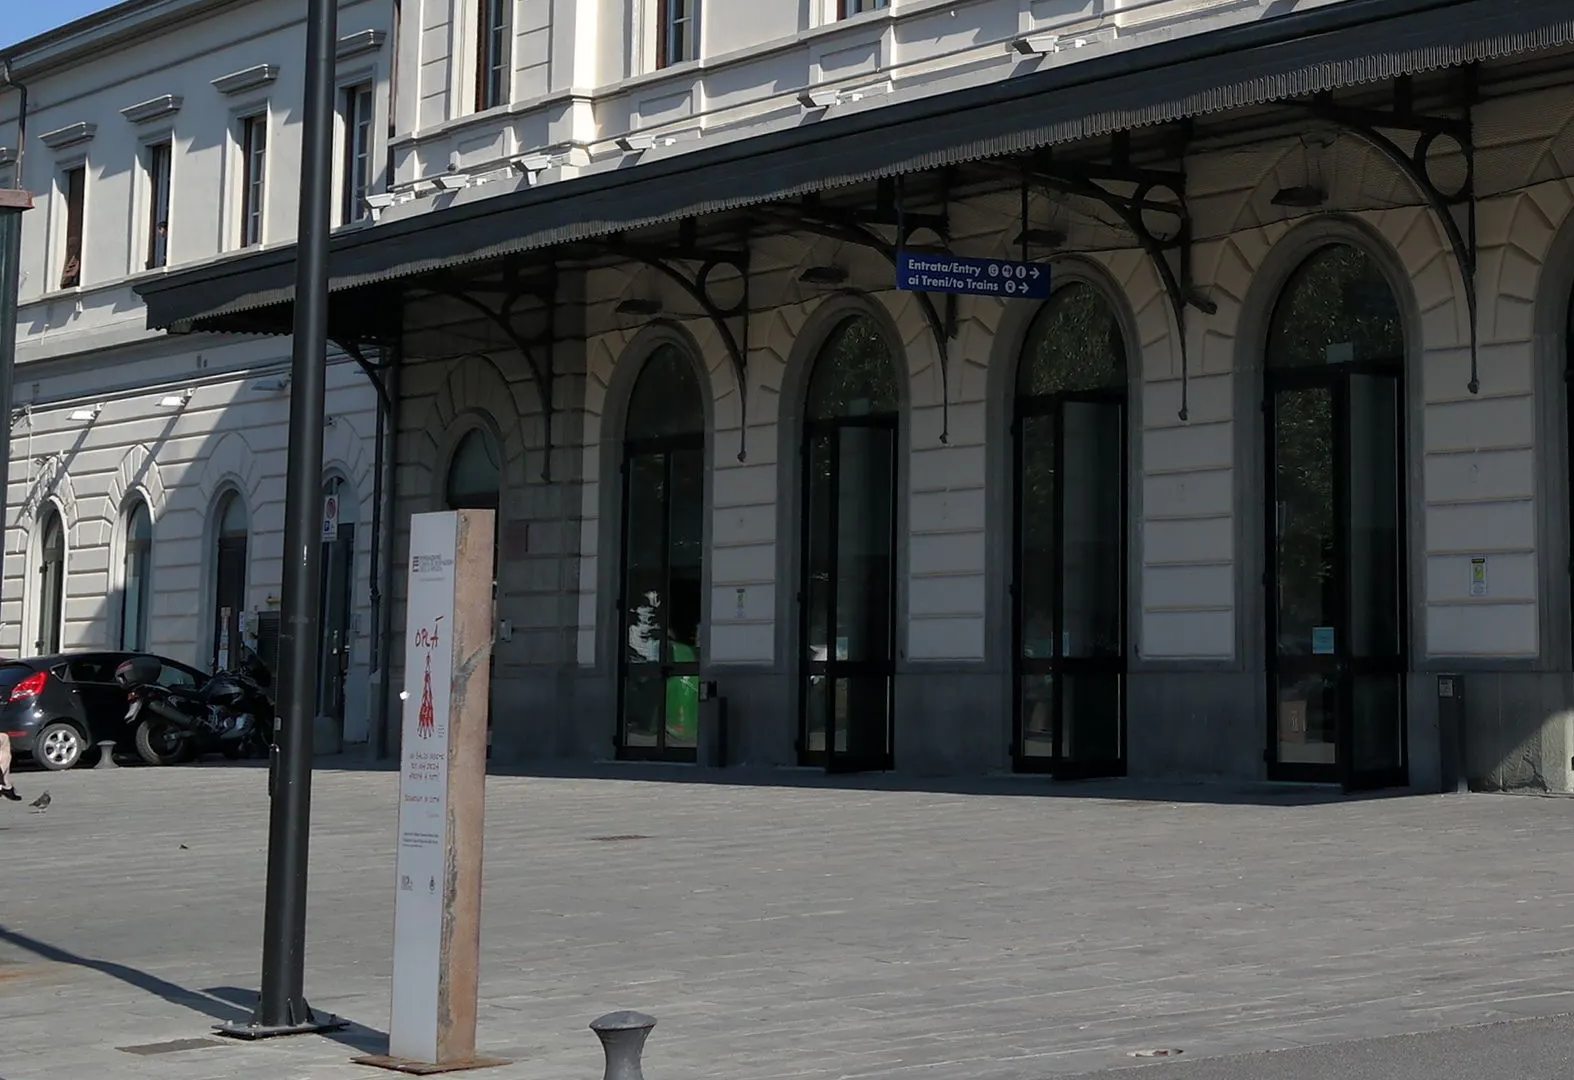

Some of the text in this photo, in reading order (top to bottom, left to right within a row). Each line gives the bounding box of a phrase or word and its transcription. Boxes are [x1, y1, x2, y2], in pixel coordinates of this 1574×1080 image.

[908, 259, 981, 277] Entrata/Entry
[908, 275, 999, 291] ai Treni/to Trains
